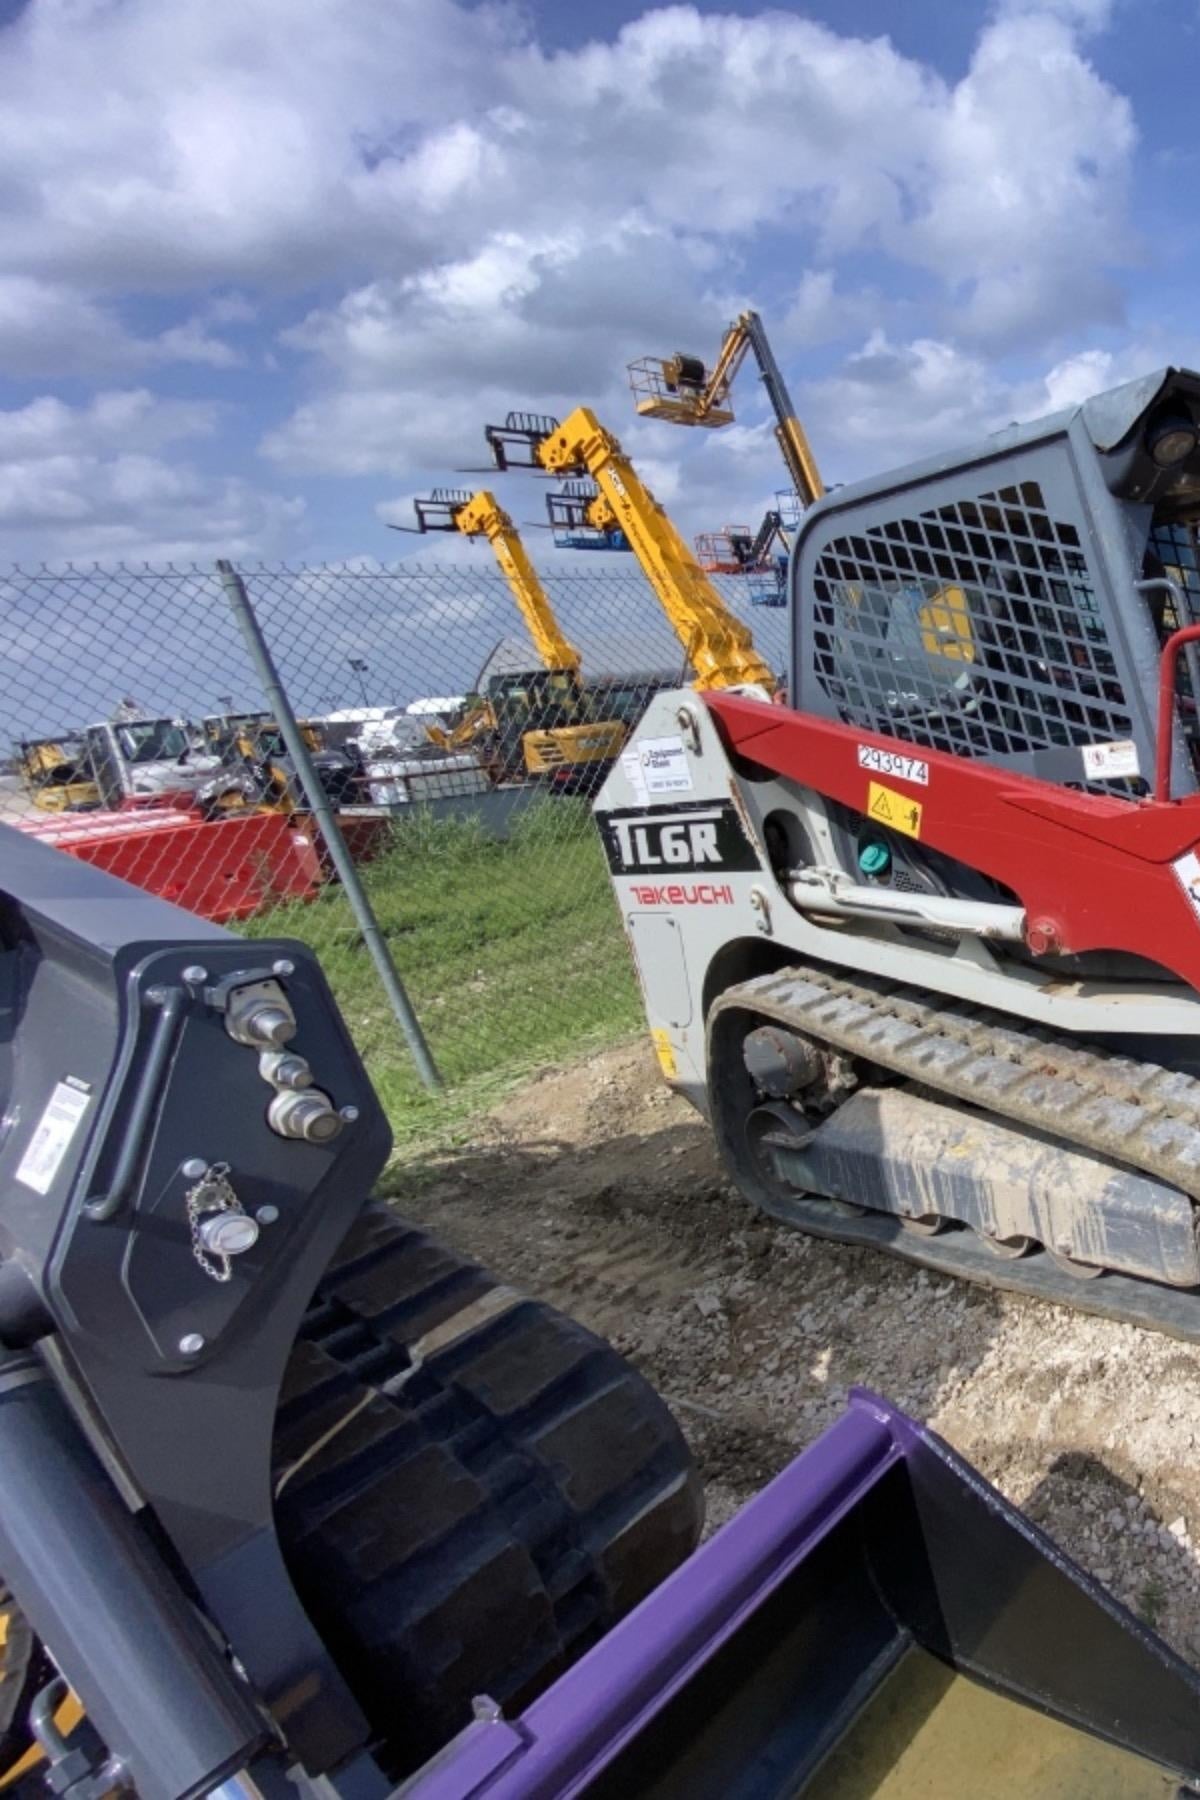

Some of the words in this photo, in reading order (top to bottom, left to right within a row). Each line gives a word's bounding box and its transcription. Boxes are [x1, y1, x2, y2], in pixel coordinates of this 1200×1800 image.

[860, 746, 926, 782] 293974
[609, 812, 723, 867] TL6R
[630, 885, 733, 906] TAKEUCHI
